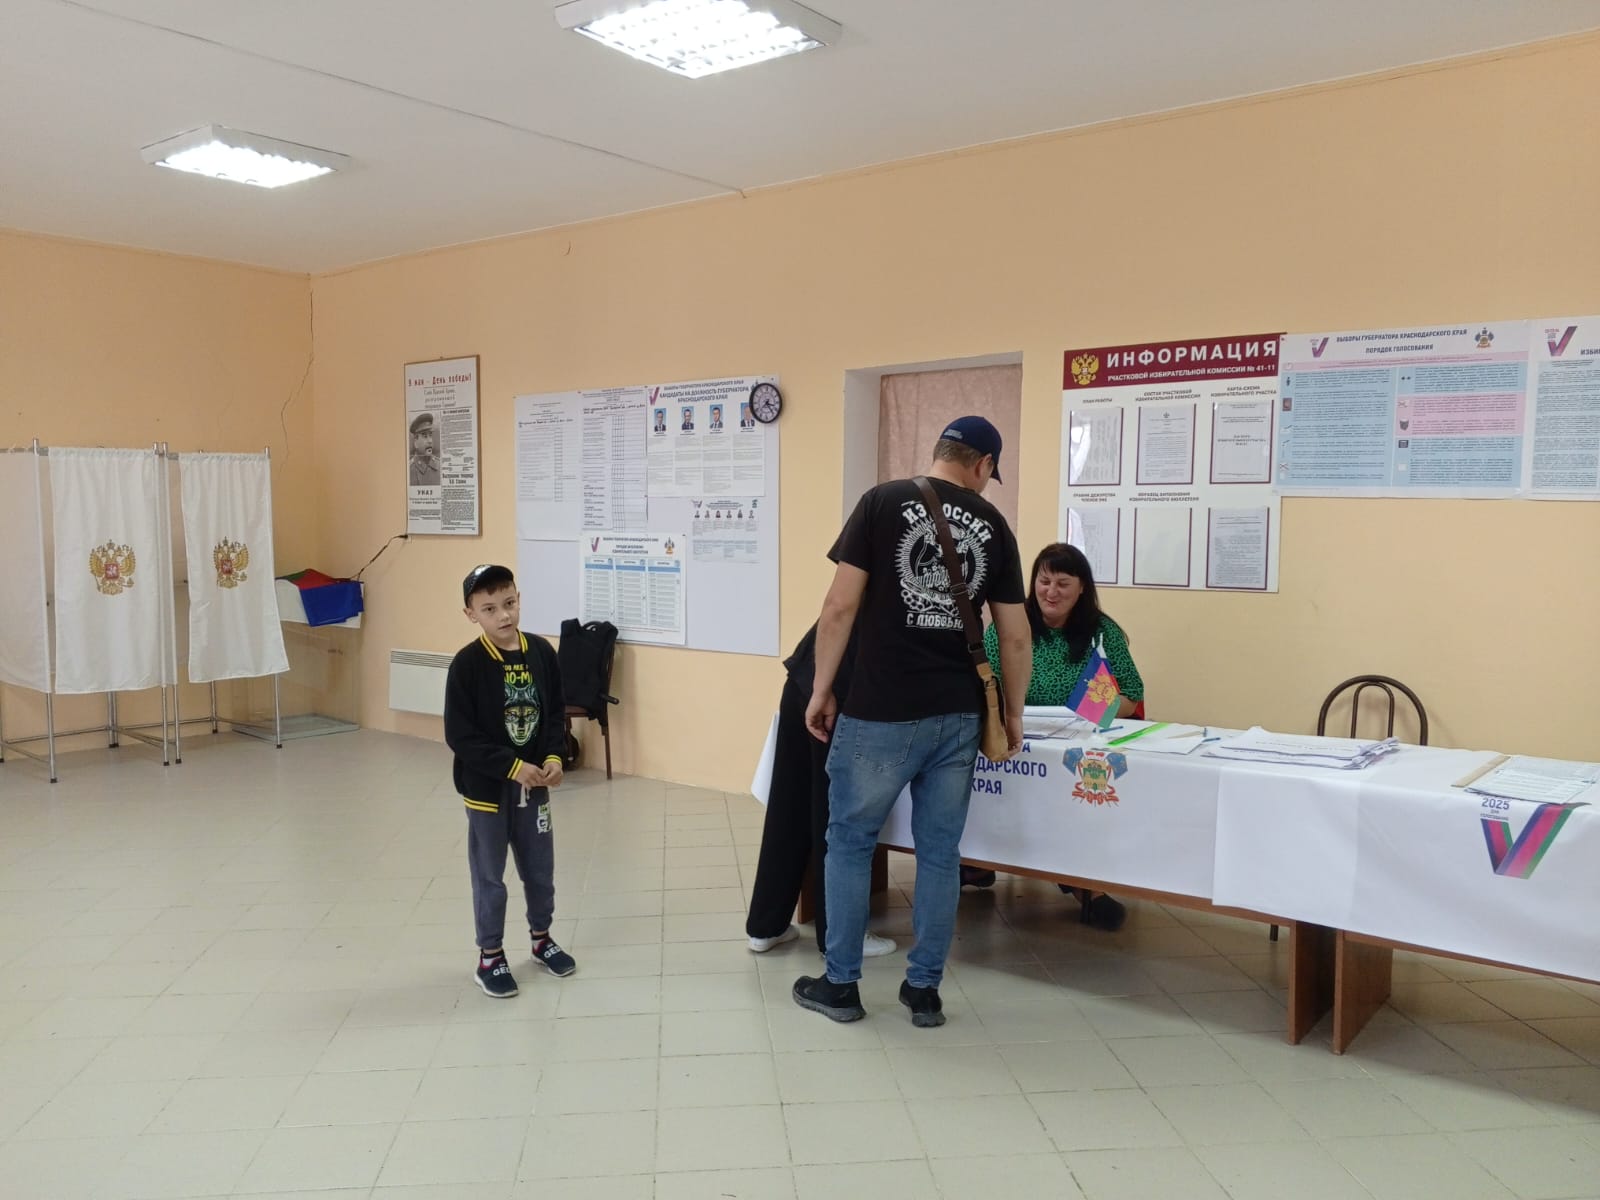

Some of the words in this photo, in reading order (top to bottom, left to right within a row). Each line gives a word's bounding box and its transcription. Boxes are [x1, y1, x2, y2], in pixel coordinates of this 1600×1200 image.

[1337, 335, 1361, 343] ВЫБОРЫ
[1361, 333, 1398, 341] ГУБЕРНАТОРА
[1400, 329, 1451, 339] КРАСНОДАРСКОГО
[1452, 328, 1467, 336] КРАЯ
[1106, 340, 1276, 368] ИНФОРМАЦИЯ
[1366, 346, 1393, 354] ПОРЯДОК
[1393, 343, 1434, 352] ГОЛОСОВАНИЯ
[1107, 372, 1149, 382] УЧАСТКОВОЙ
[1149, 367, 1206, 379] ИЗБИРАТЕЛЬНОЙ
[1207, 365, 1246, 375] КОМИССИИ
[1256, 363, 1275, 371] 41-11
[902, 503, 927, 525] ИЗ
[942, 503, 992, 543] ОССИИ
[906, 613, 914, 625] С
[975, 756, 1047, 778] ДАРСКОГО
[1481, 797, 1510, 810] 2025
